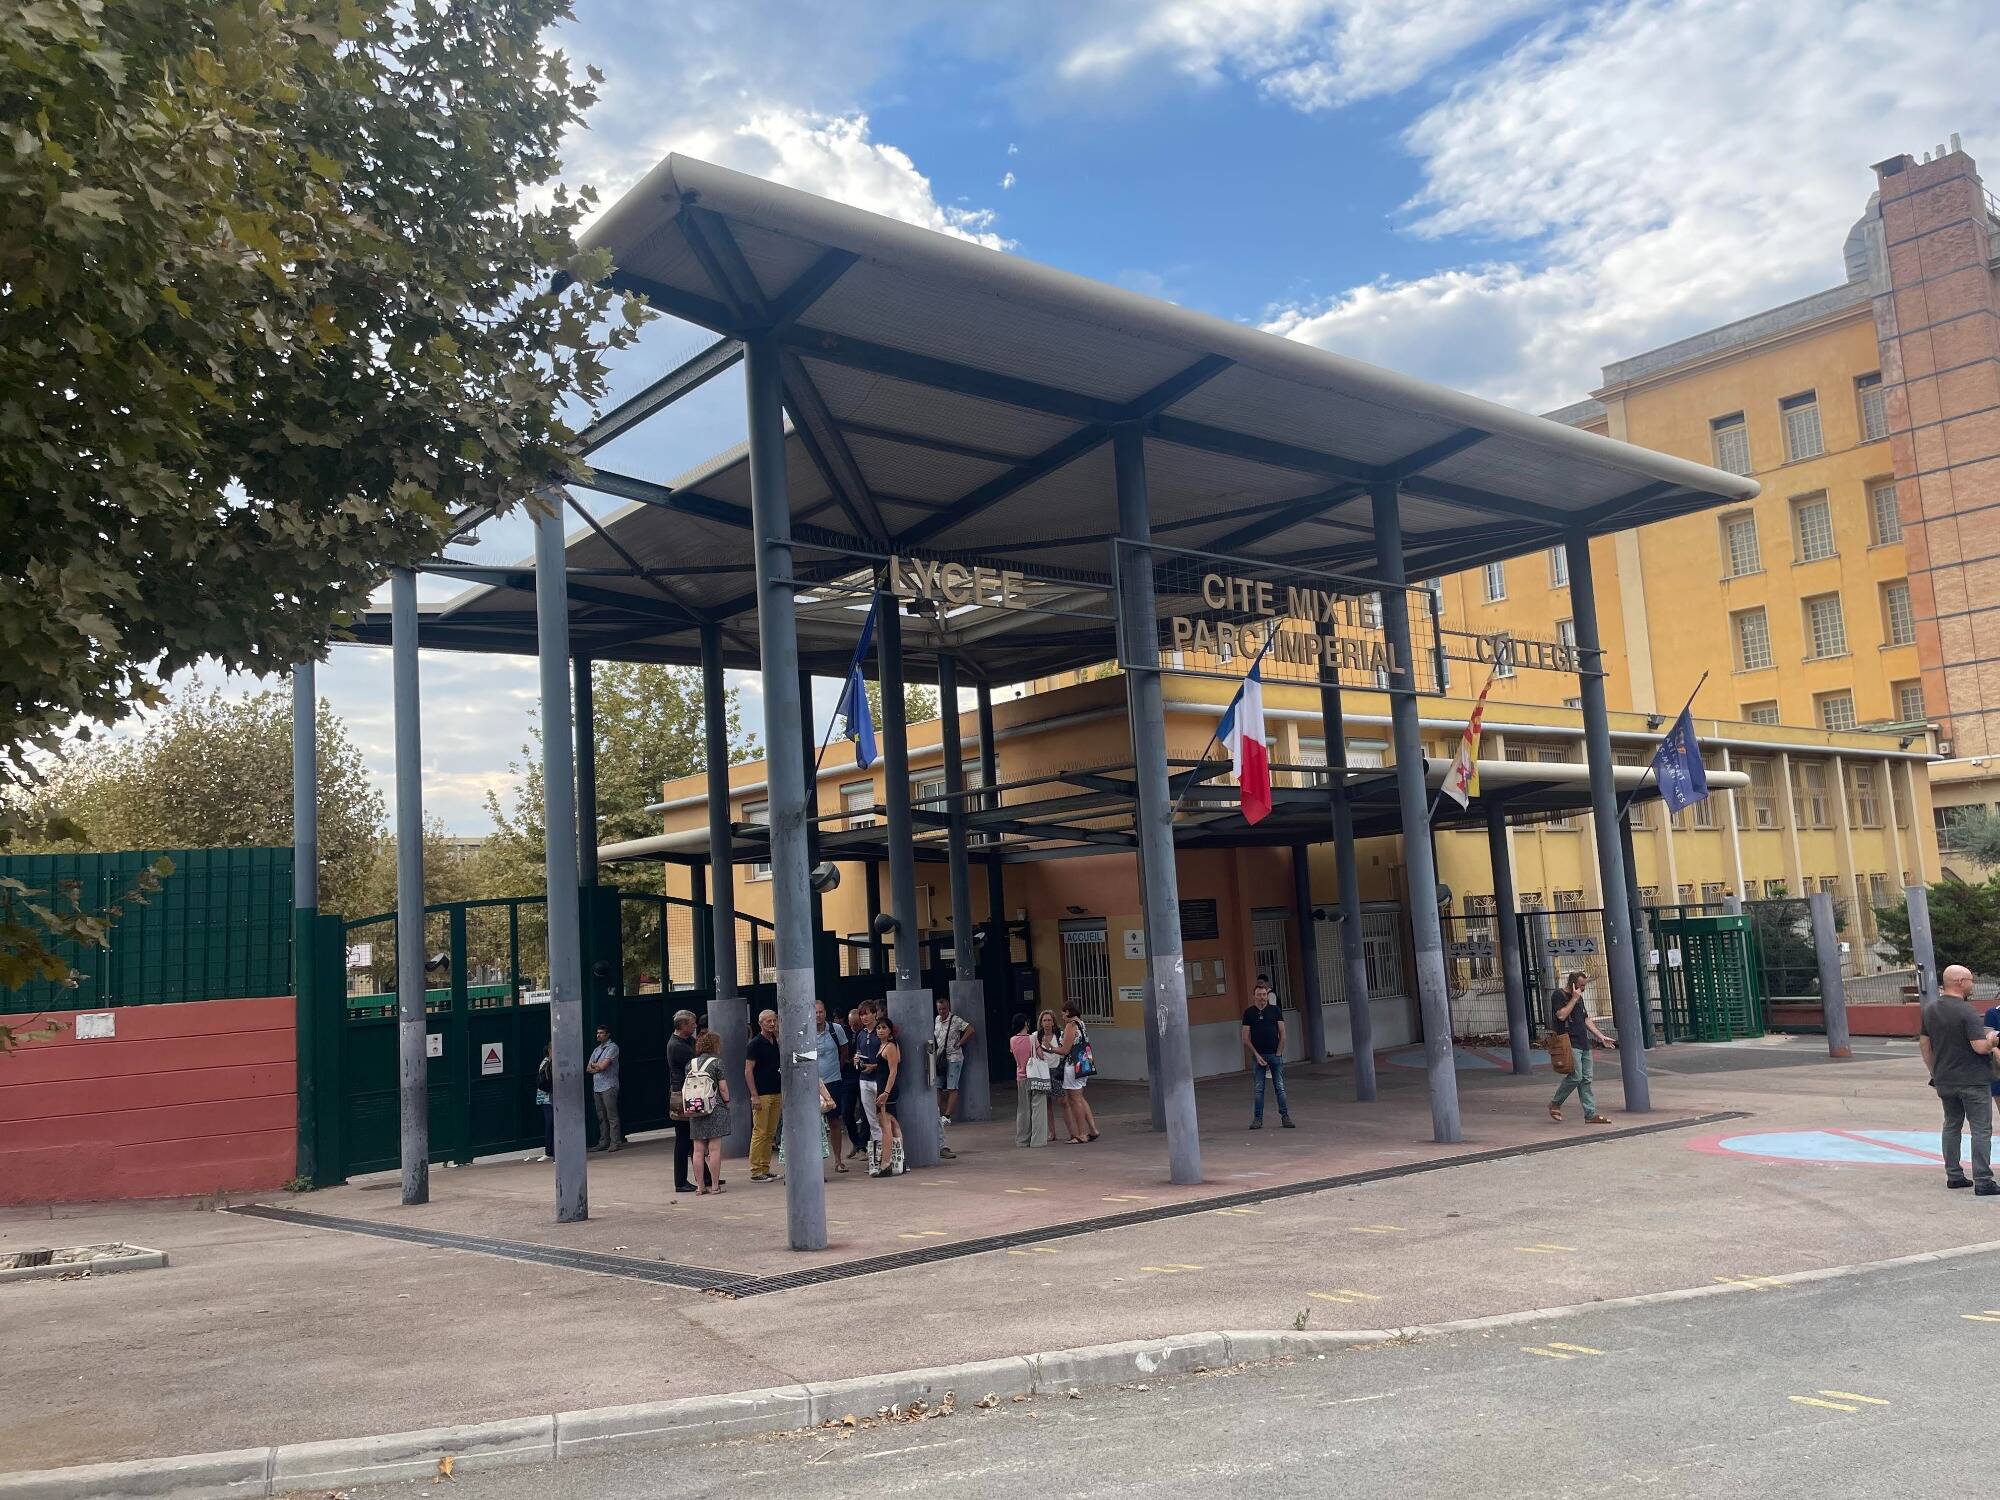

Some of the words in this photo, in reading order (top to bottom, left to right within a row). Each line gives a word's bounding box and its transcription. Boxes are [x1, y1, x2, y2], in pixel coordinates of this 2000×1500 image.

[889, 554, 1027, 610] LYCEE
[1203, 573, 1275, 616] CITE
[1287, 586, 1377, 629] MIXTE
[1172, 616, 1262, 660] PARC
[1273, 629, 1406, 675] IMPERIAL
[1476, 636, 1583, 673] COLLEGE
[1067, 931, 1102, 941] ACCUEIL
[1450, 942, 1492, 950] GRETA
[1547, 939, 1594, 948] GRETA
